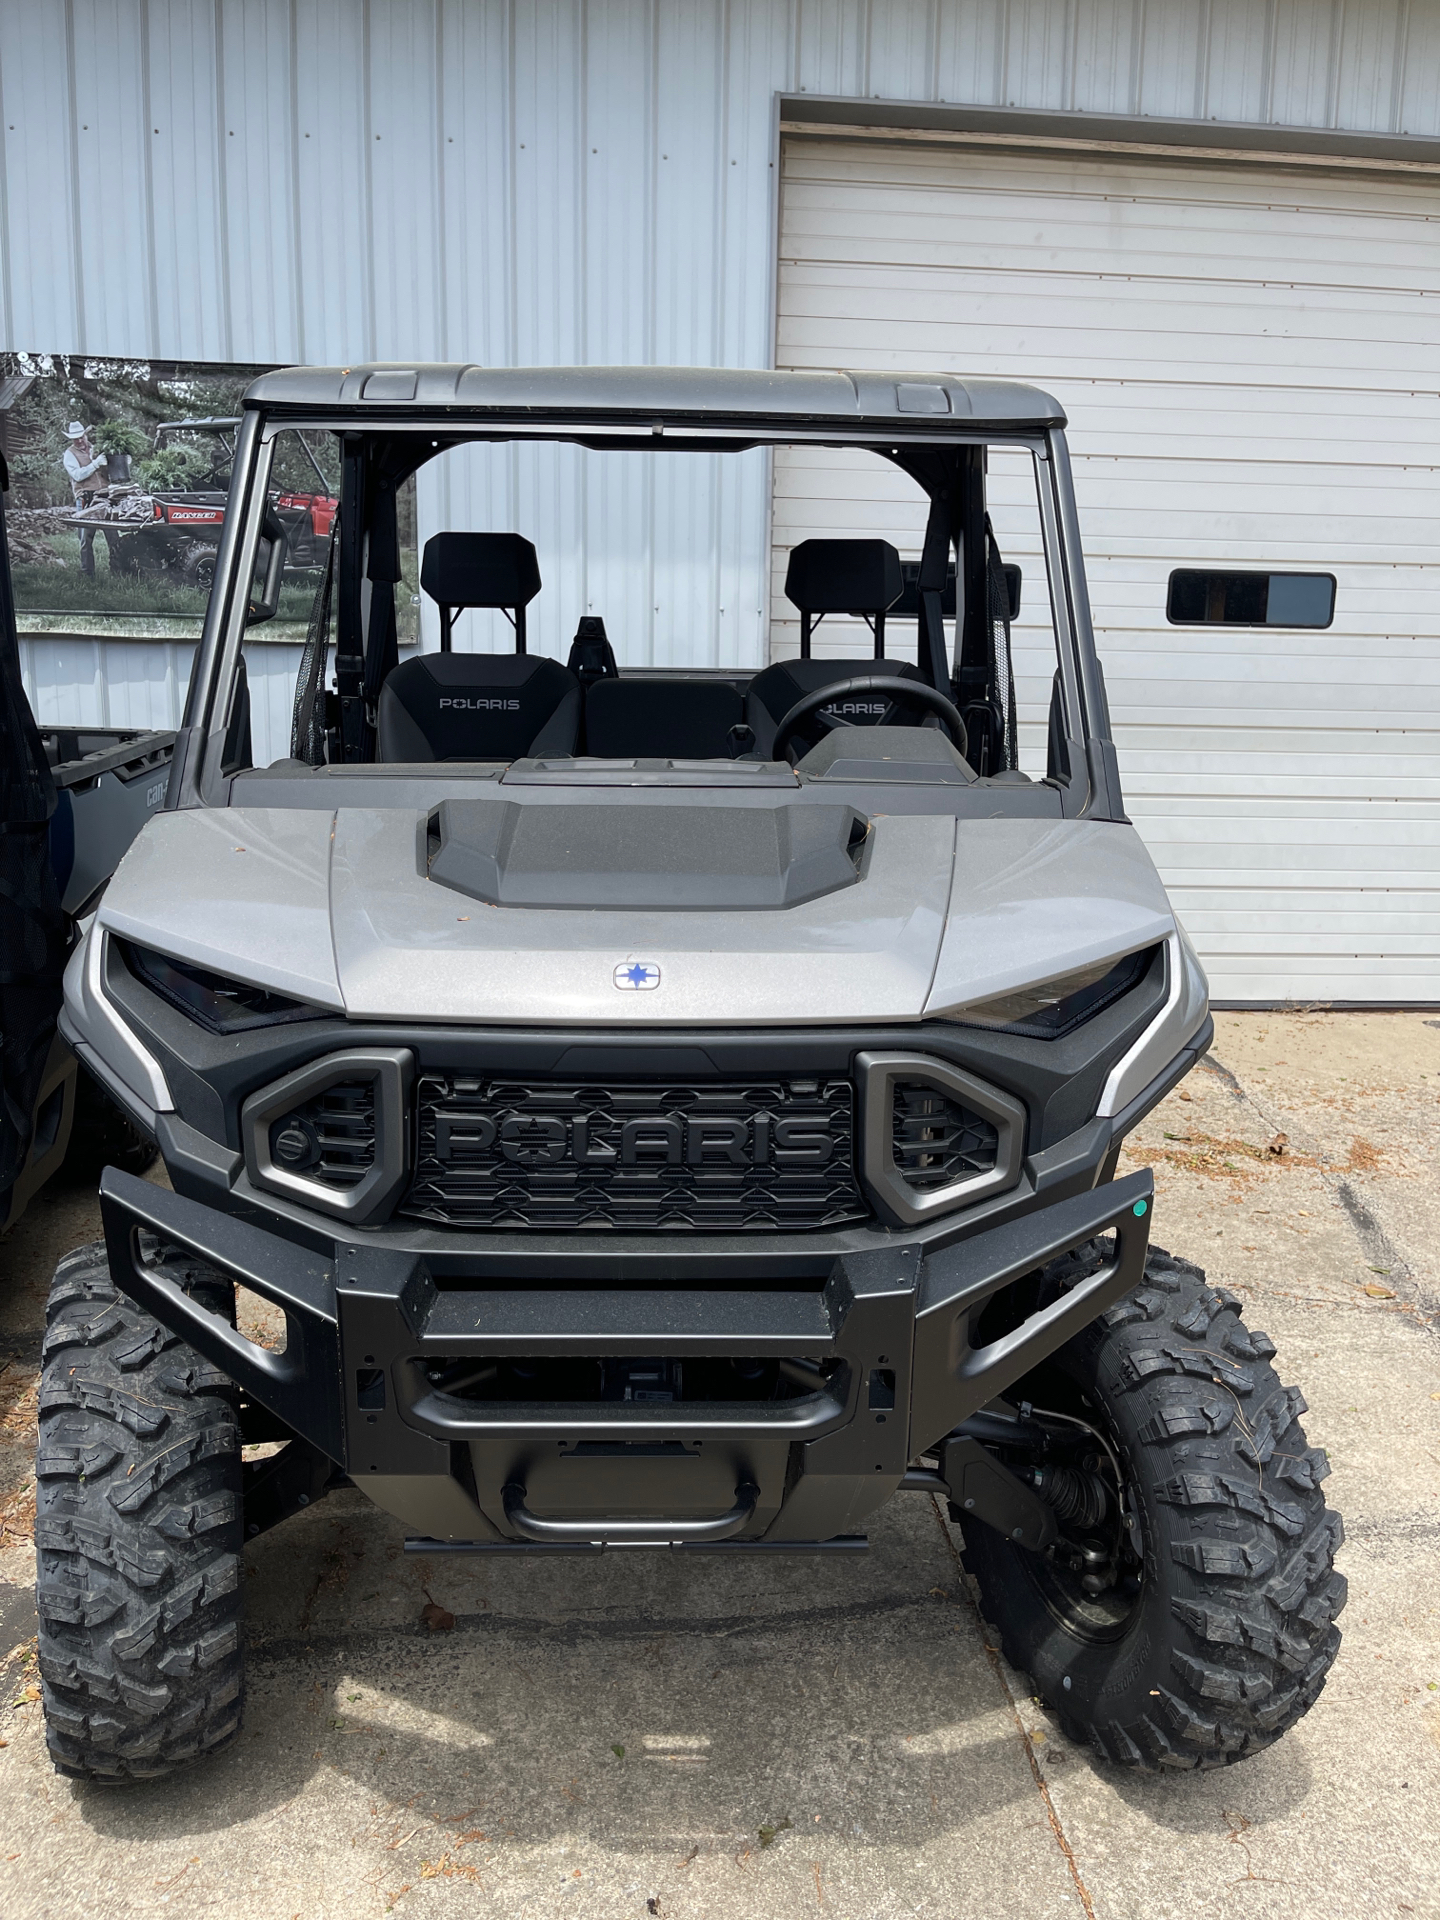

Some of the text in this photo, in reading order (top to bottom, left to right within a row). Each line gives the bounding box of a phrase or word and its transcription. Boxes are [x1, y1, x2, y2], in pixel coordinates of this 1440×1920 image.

[439, 698, 520, 710] POLARIS
[147, 779, 169, 808] can-
[434, 1112, 835, 1164] POLARIS
